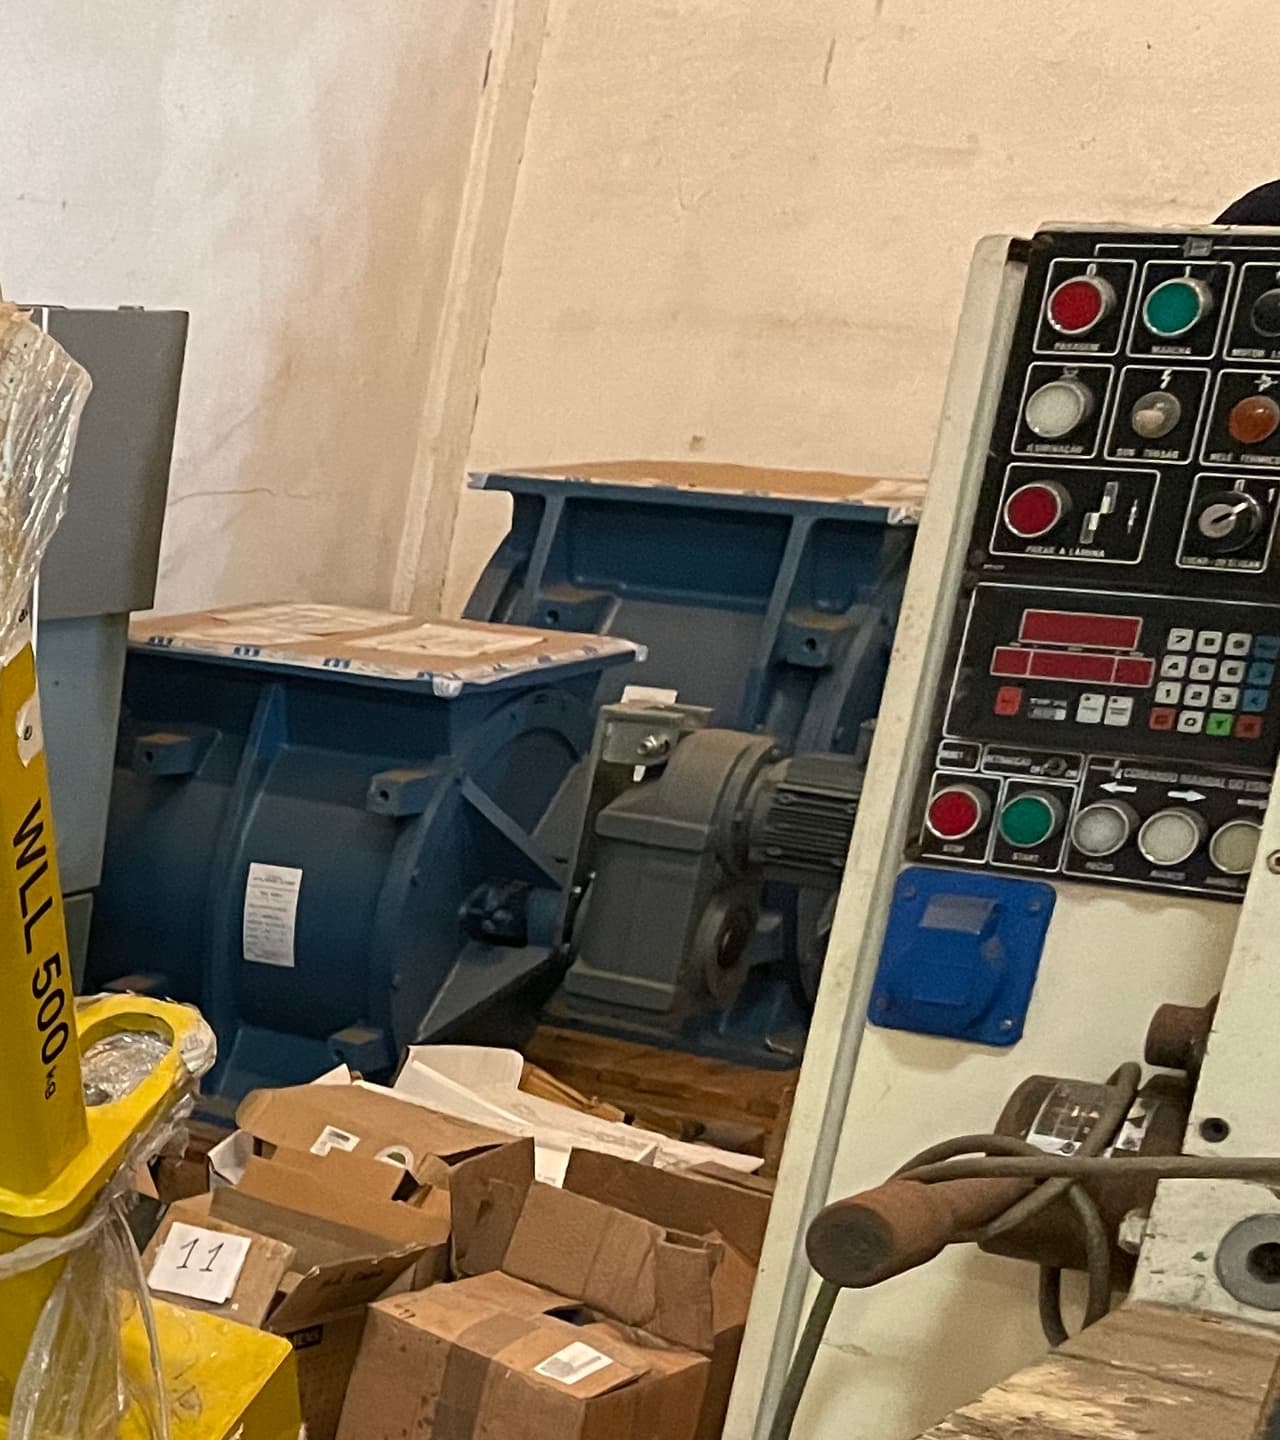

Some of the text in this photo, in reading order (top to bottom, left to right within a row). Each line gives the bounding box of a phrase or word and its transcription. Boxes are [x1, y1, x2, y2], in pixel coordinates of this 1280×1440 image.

[13, 797, 53, 954] WLL
[32, 951, 69, 1066] 500
[176, 1238, 224, 1272] 11
